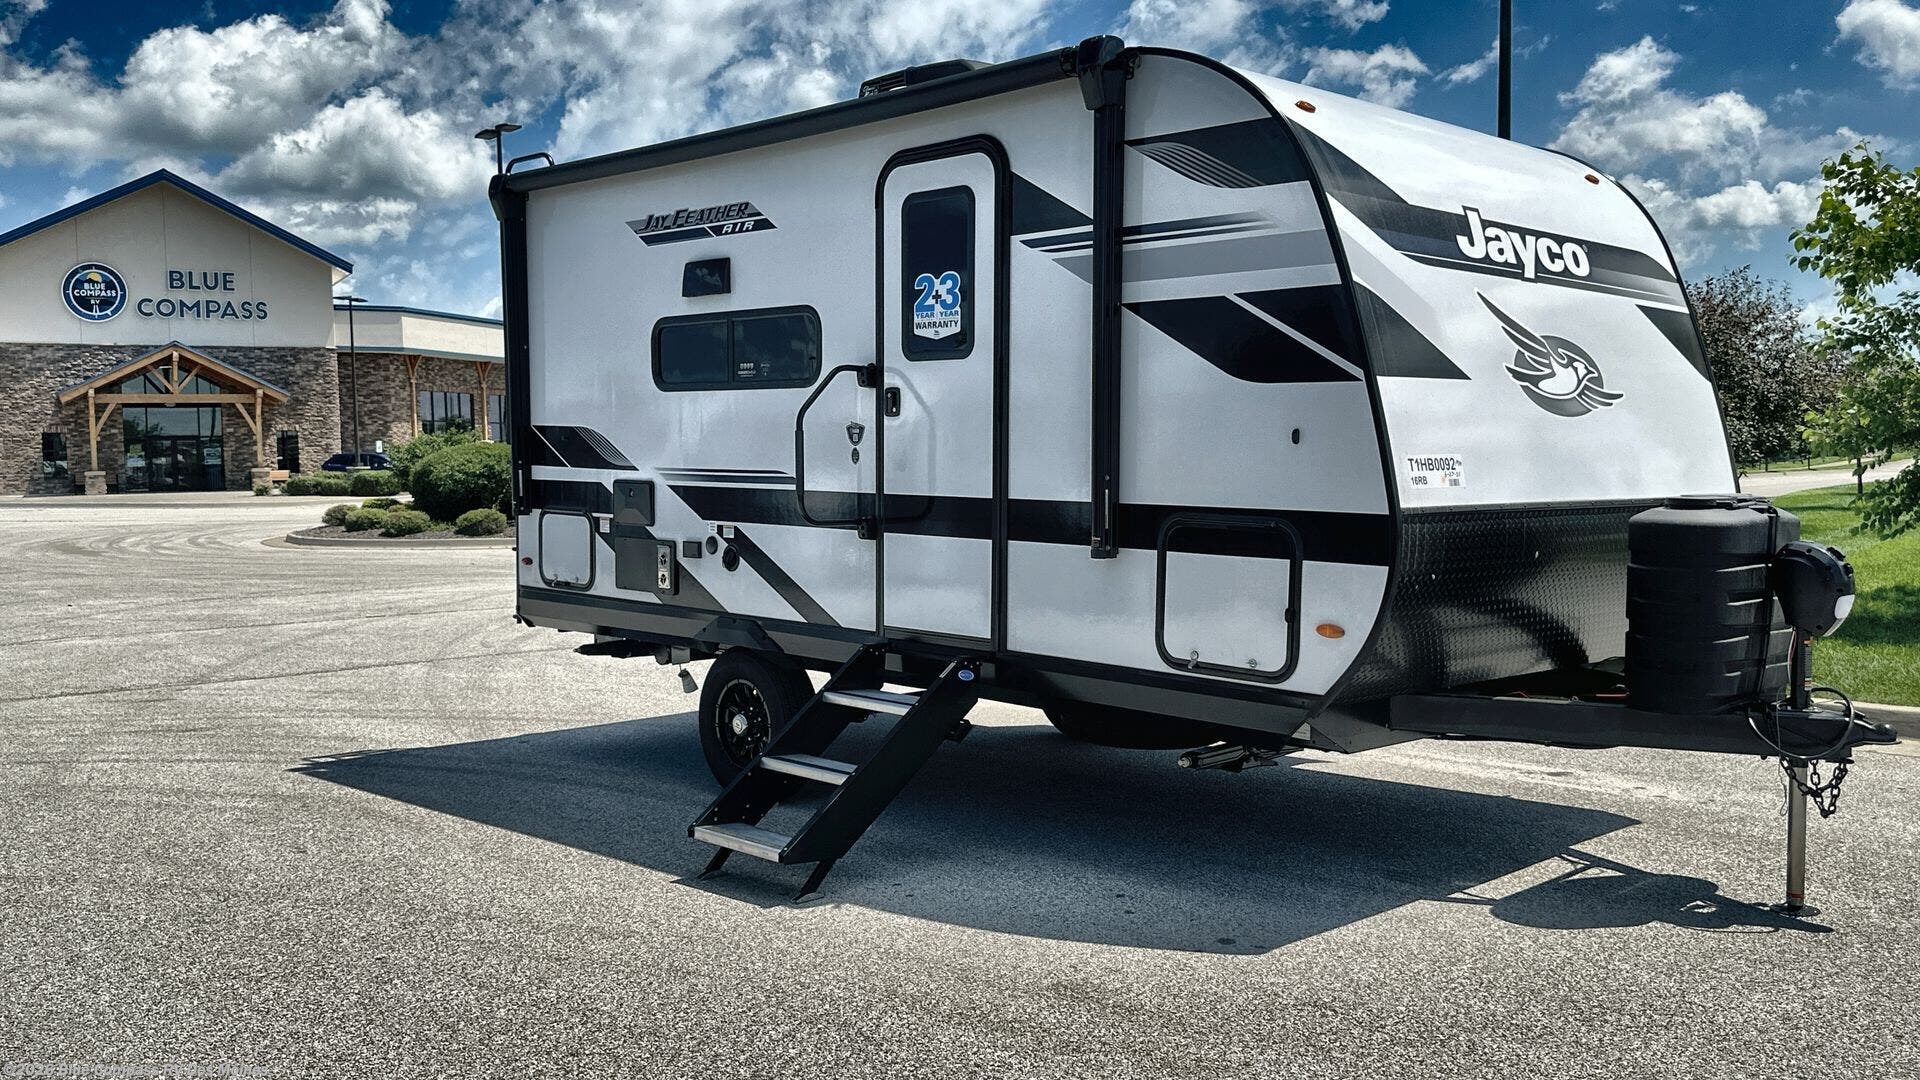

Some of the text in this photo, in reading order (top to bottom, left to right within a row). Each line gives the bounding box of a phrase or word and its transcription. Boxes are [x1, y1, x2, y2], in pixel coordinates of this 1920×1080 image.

[638, 201, 751, 232] JAY FEATHER
[722, 221, 754, 234] AIR
[1456, 209, 1590, 279] Jayco
[83, 282, 106, 290] BLUE
[168, 270, 235, 292] BLUE
[73, 289, 117, 297] COMPASS
[137, 298, 269, 320] COMPASS
[939, 310, 959, 318] YEAR
[915, 320, 959, 330] WARRANTY
[1407, 457, 1456, 472] T1HB0092
[1411, 476, 1428, 485] 16RB
